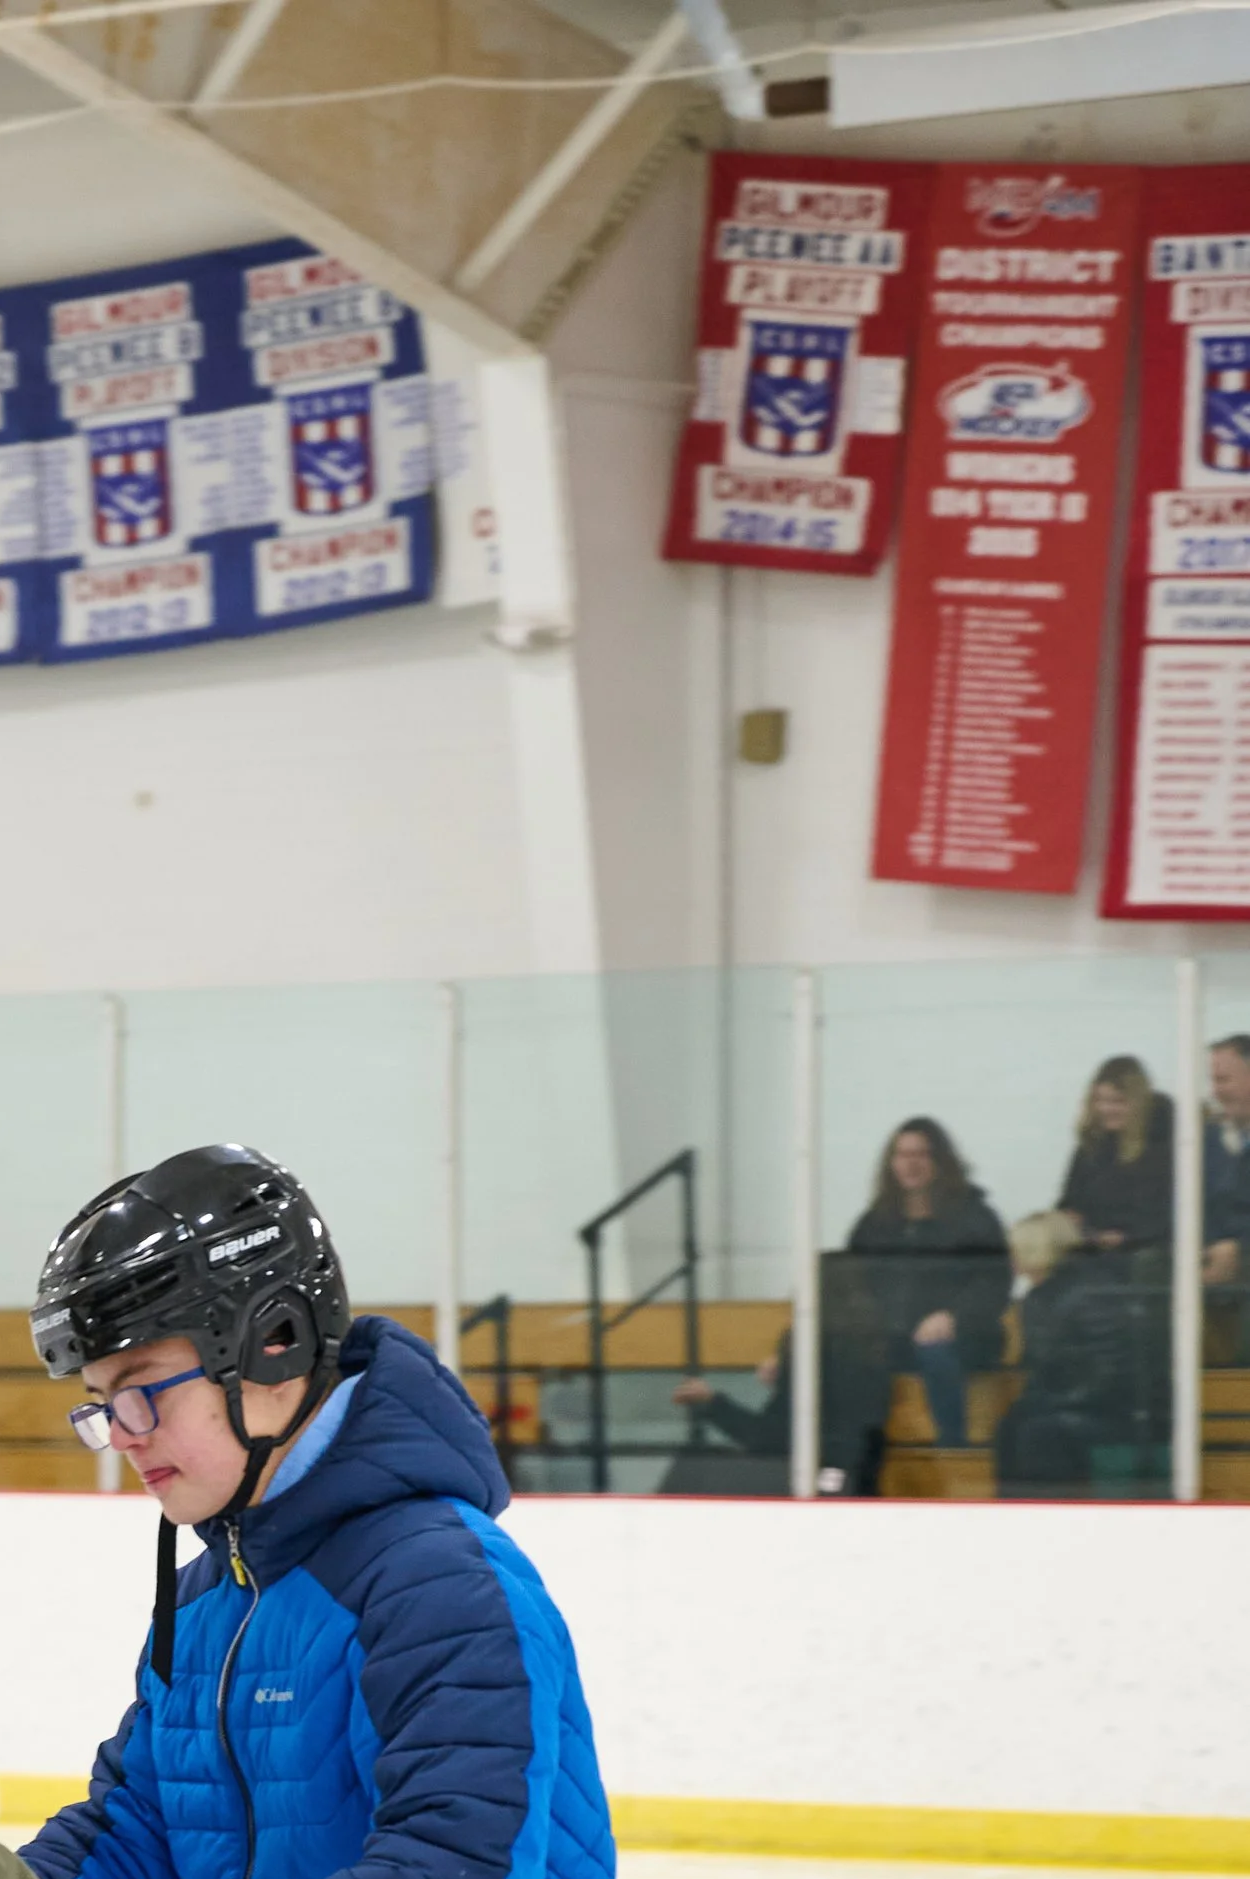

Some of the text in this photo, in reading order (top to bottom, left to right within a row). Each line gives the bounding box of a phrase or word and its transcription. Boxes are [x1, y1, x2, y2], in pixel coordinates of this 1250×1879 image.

[742, 188, 881, 222] GILMOUR
[722, 226, 846, 262] PEEWEE
[936, 249, 1121, 282] DISTRICT
[740, 272, 868, 308] PLAYOFF
[55, 288, 183, 336] GILMOUR
[268, 335, 378, 377] DIVISION
[715, 470, 857, 508] CHAMPION
[269, 528, 398, 571] CHAMPION
[73, 563, 201, 602] CHAMPION
[209, 1224, 281, 1263] BAUER
